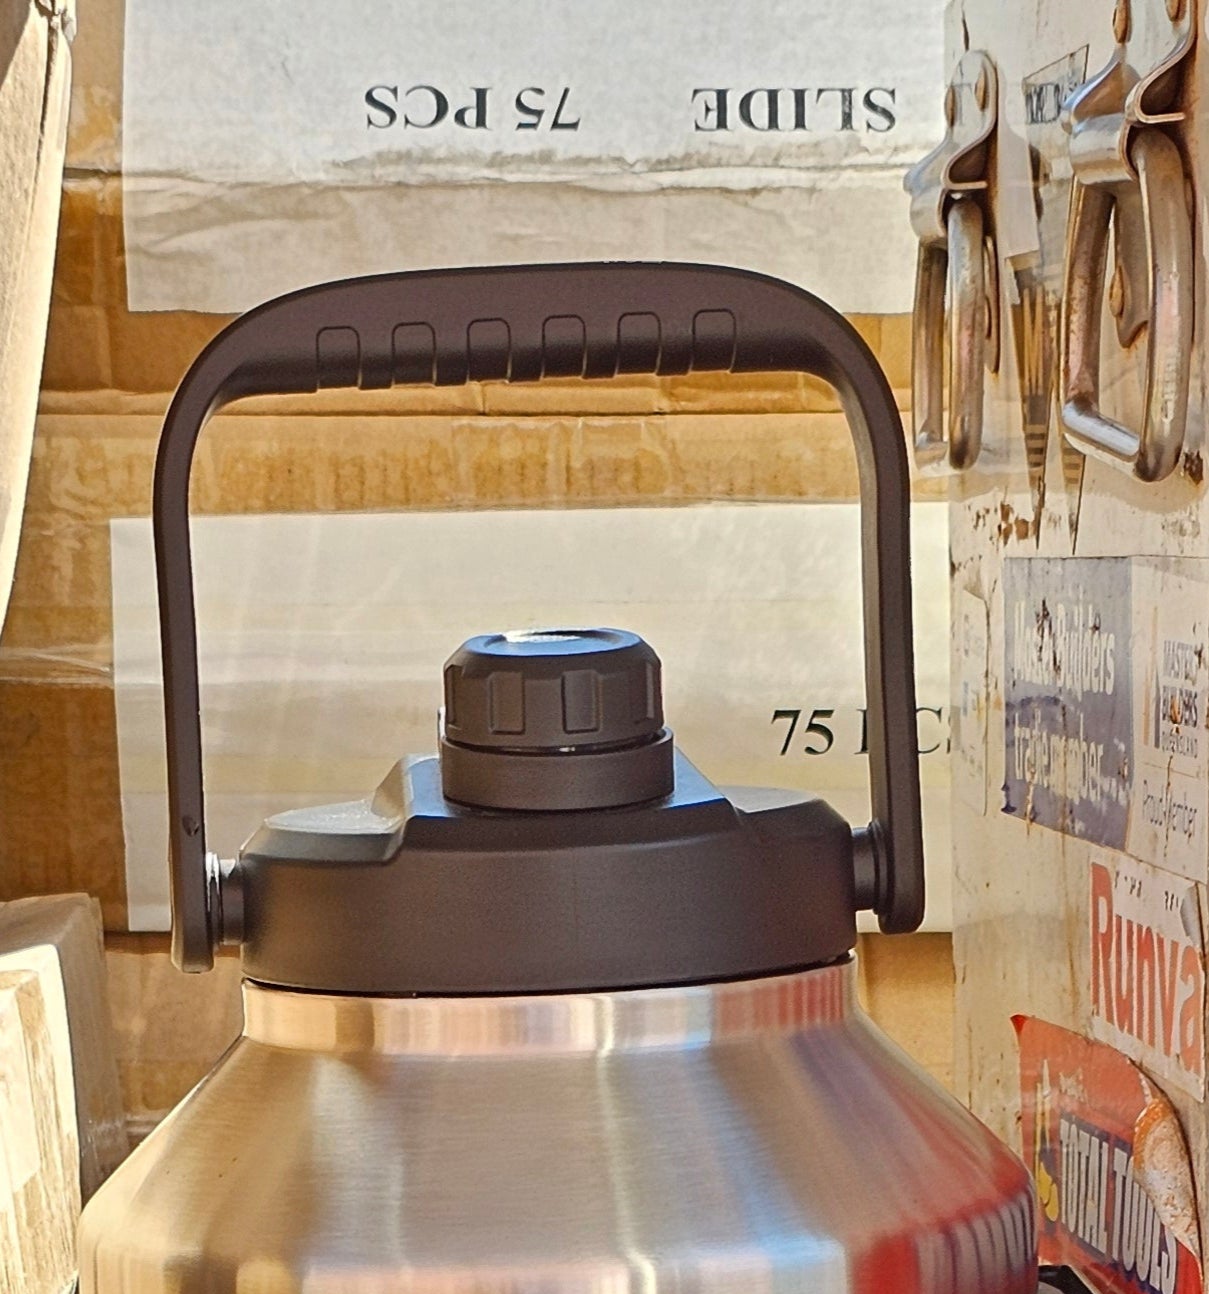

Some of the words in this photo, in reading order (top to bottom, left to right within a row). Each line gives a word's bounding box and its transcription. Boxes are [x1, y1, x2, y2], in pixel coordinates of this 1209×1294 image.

[364, 84, 488, 132] PCS
[515, 86, 582, 132] 75
[693, 86, 897, 133] SLIDE
[771, 709, 835, 756] 75
[1091, 862, 1203, 1073] Runva
[1060, 1118, 1108, 1255] TOTAL
